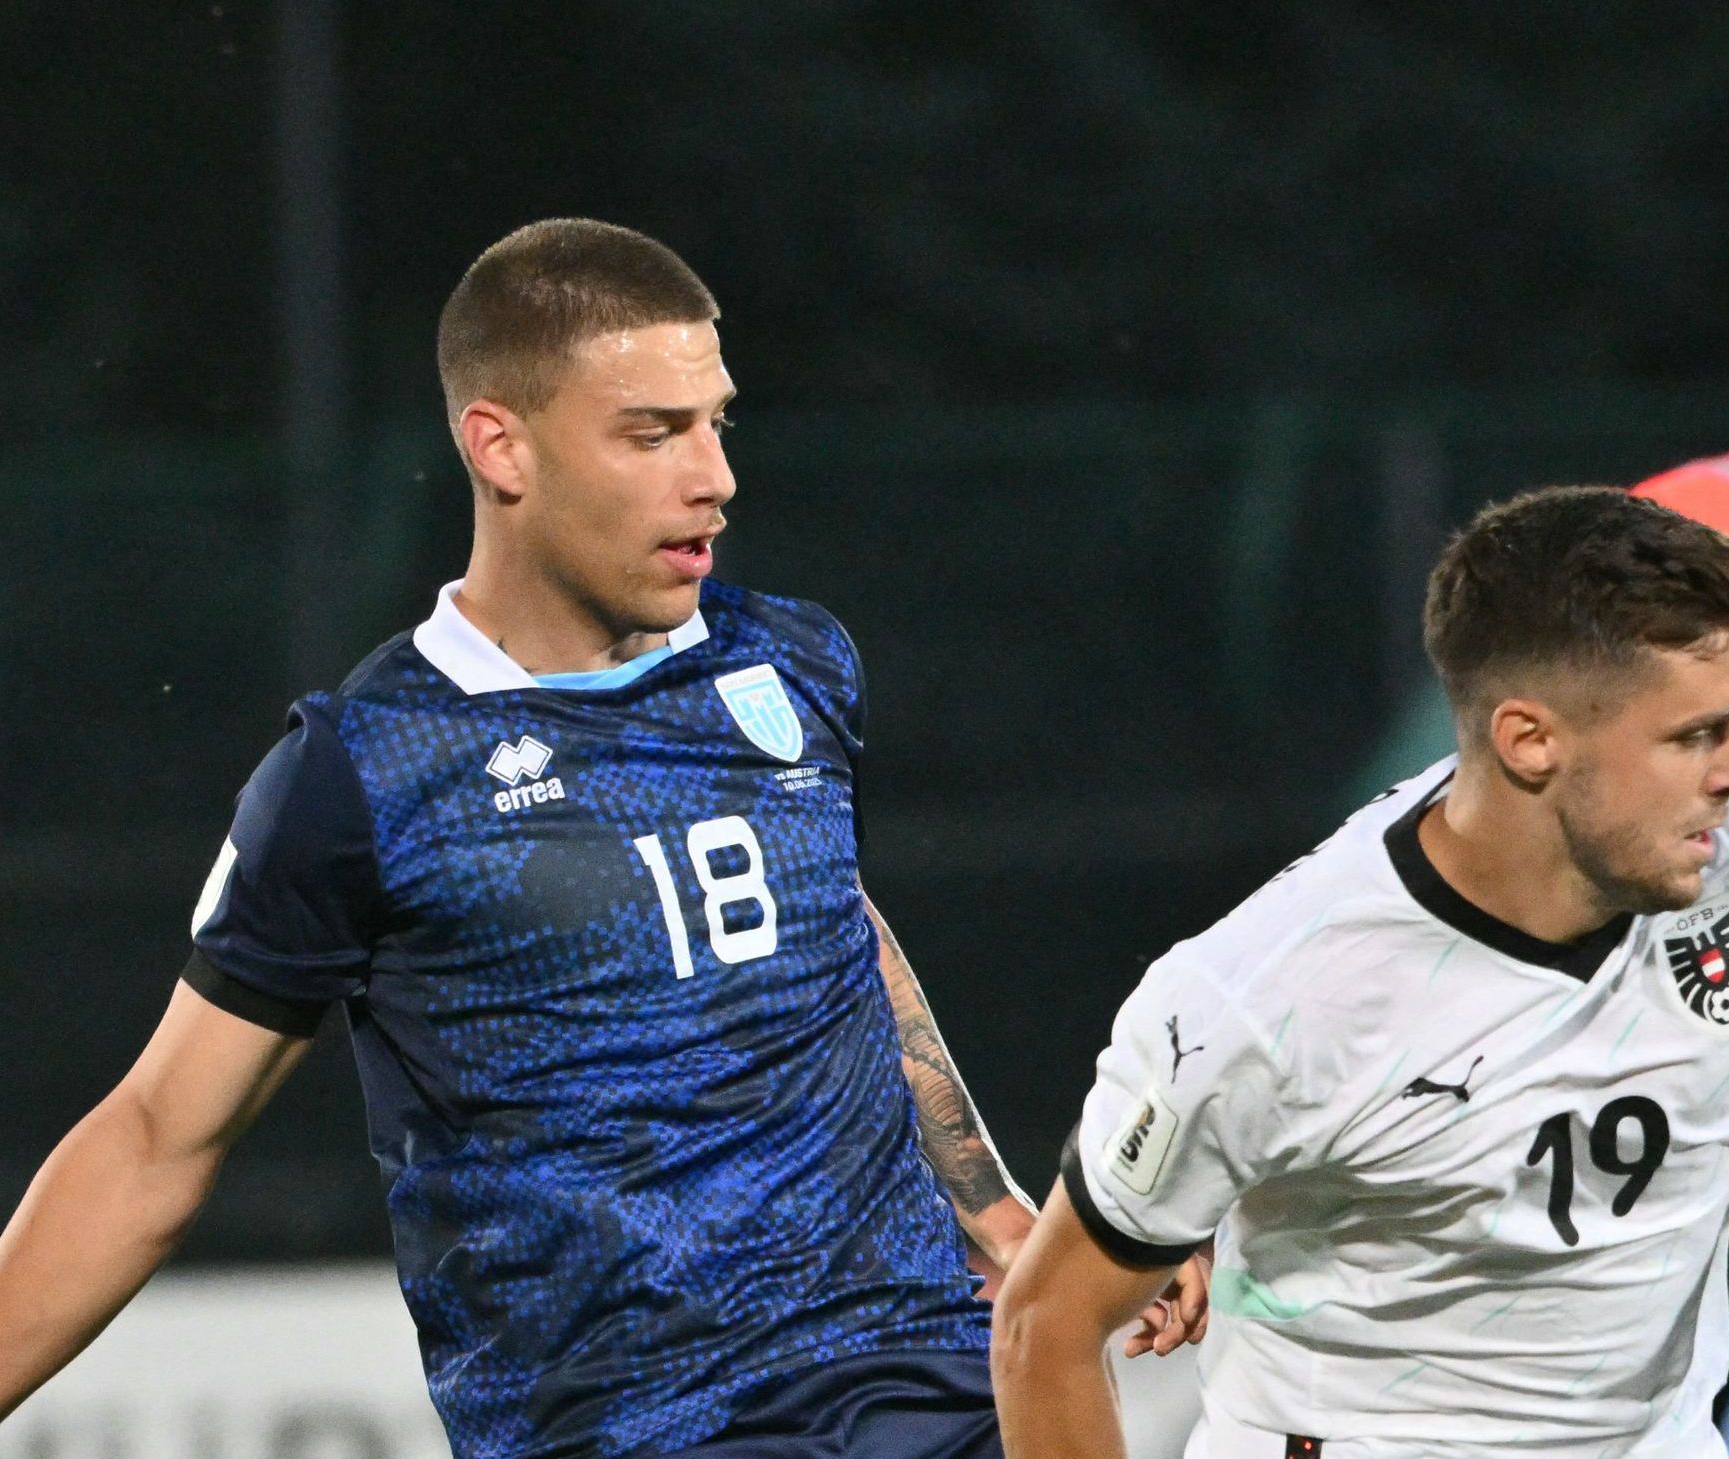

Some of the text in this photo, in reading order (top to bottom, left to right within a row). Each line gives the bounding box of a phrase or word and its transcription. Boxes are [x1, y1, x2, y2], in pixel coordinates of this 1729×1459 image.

[494, 777, 566, 813] errea
[785, 766, 820, 779] AUSTRIA
[632, 815, 778, 980] 18
[1526, 1095, 1670, 1247] 19
